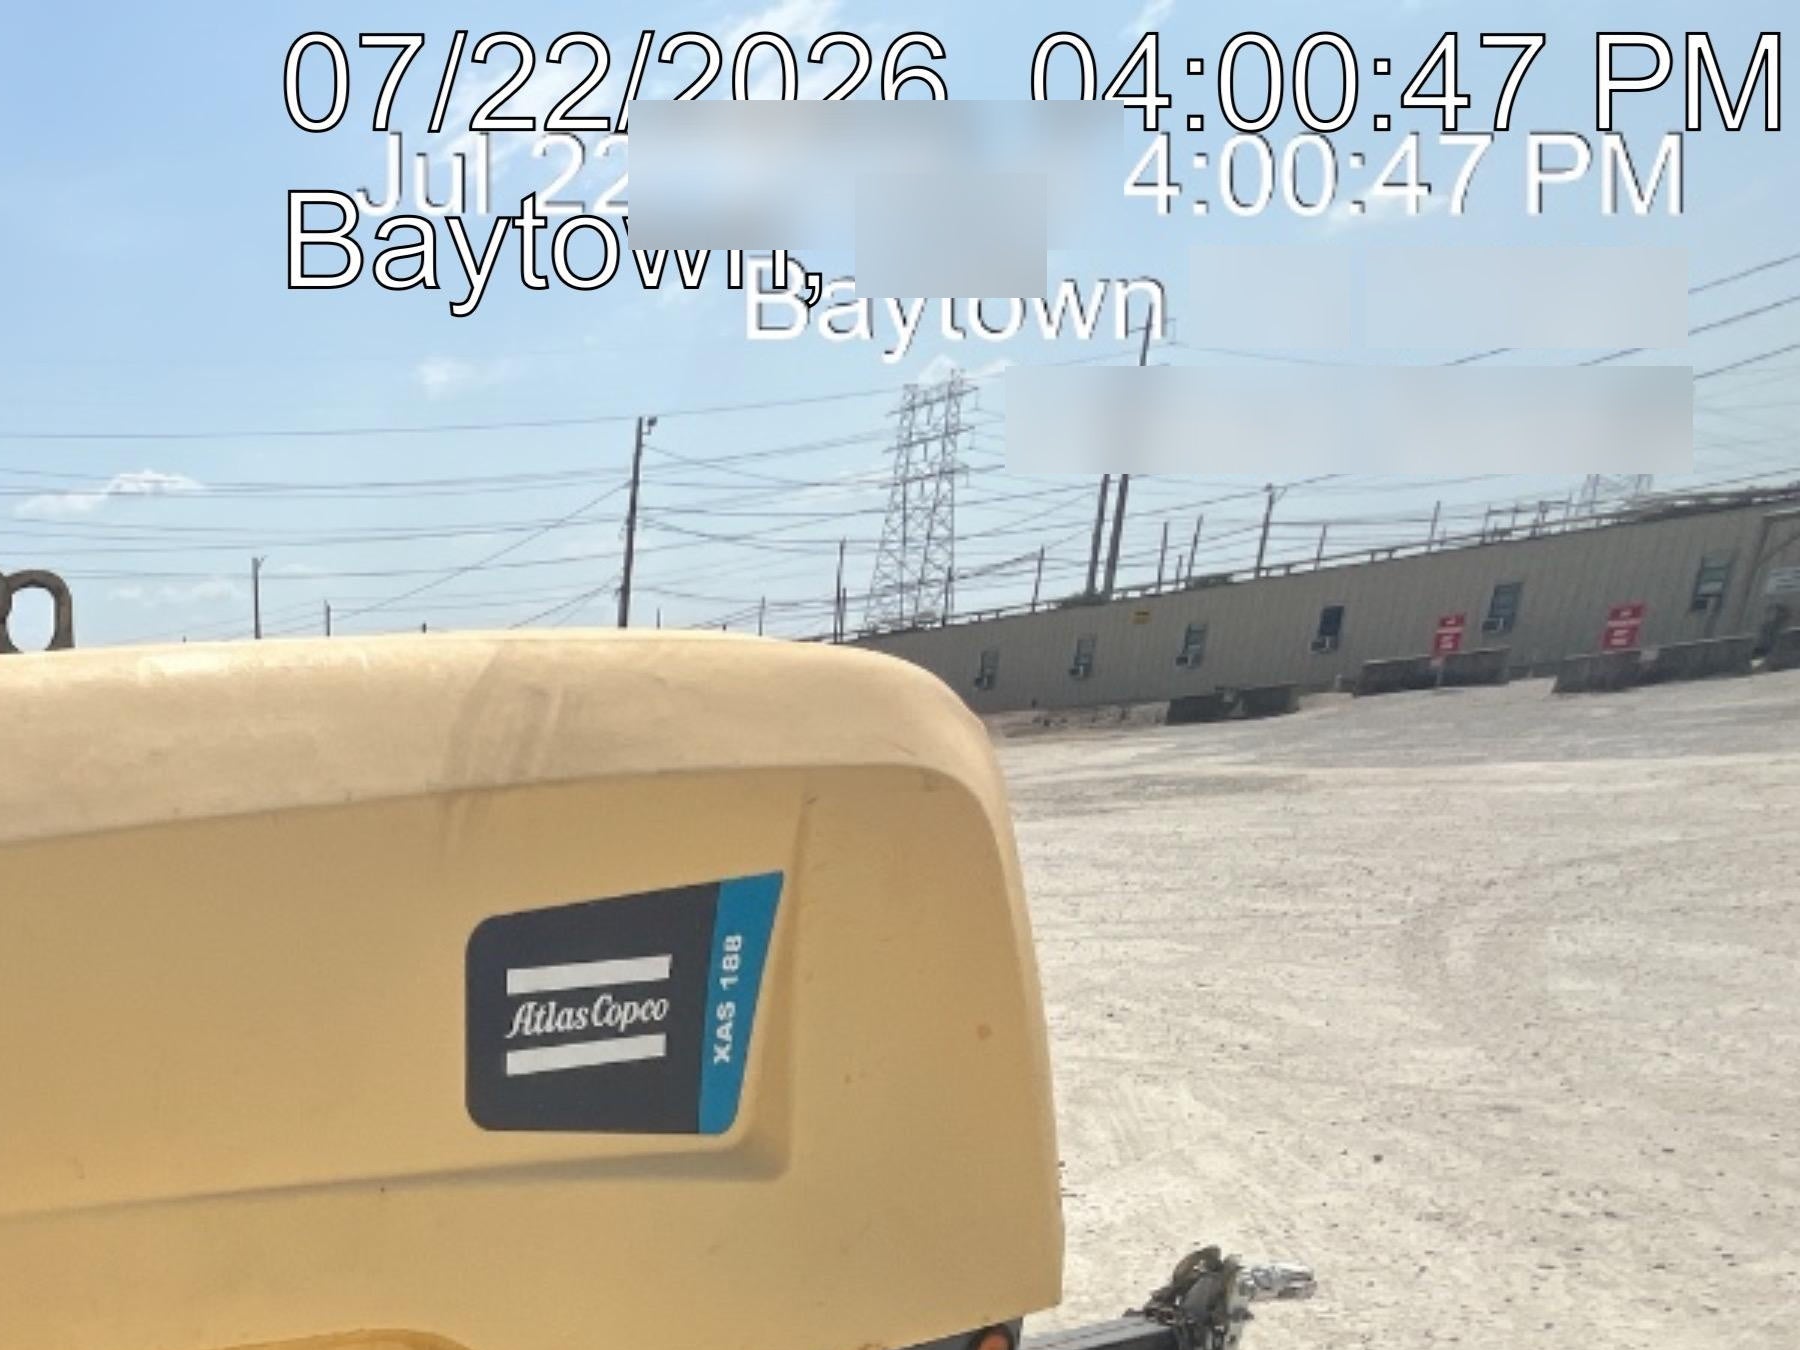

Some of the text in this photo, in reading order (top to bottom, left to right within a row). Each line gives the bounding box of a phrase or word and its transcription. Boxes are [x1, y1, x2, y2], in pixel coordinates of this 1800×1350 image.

[505, 993, 670, 1039] Atlas Copco
[712, 933, 744, 1065] XAS 188
